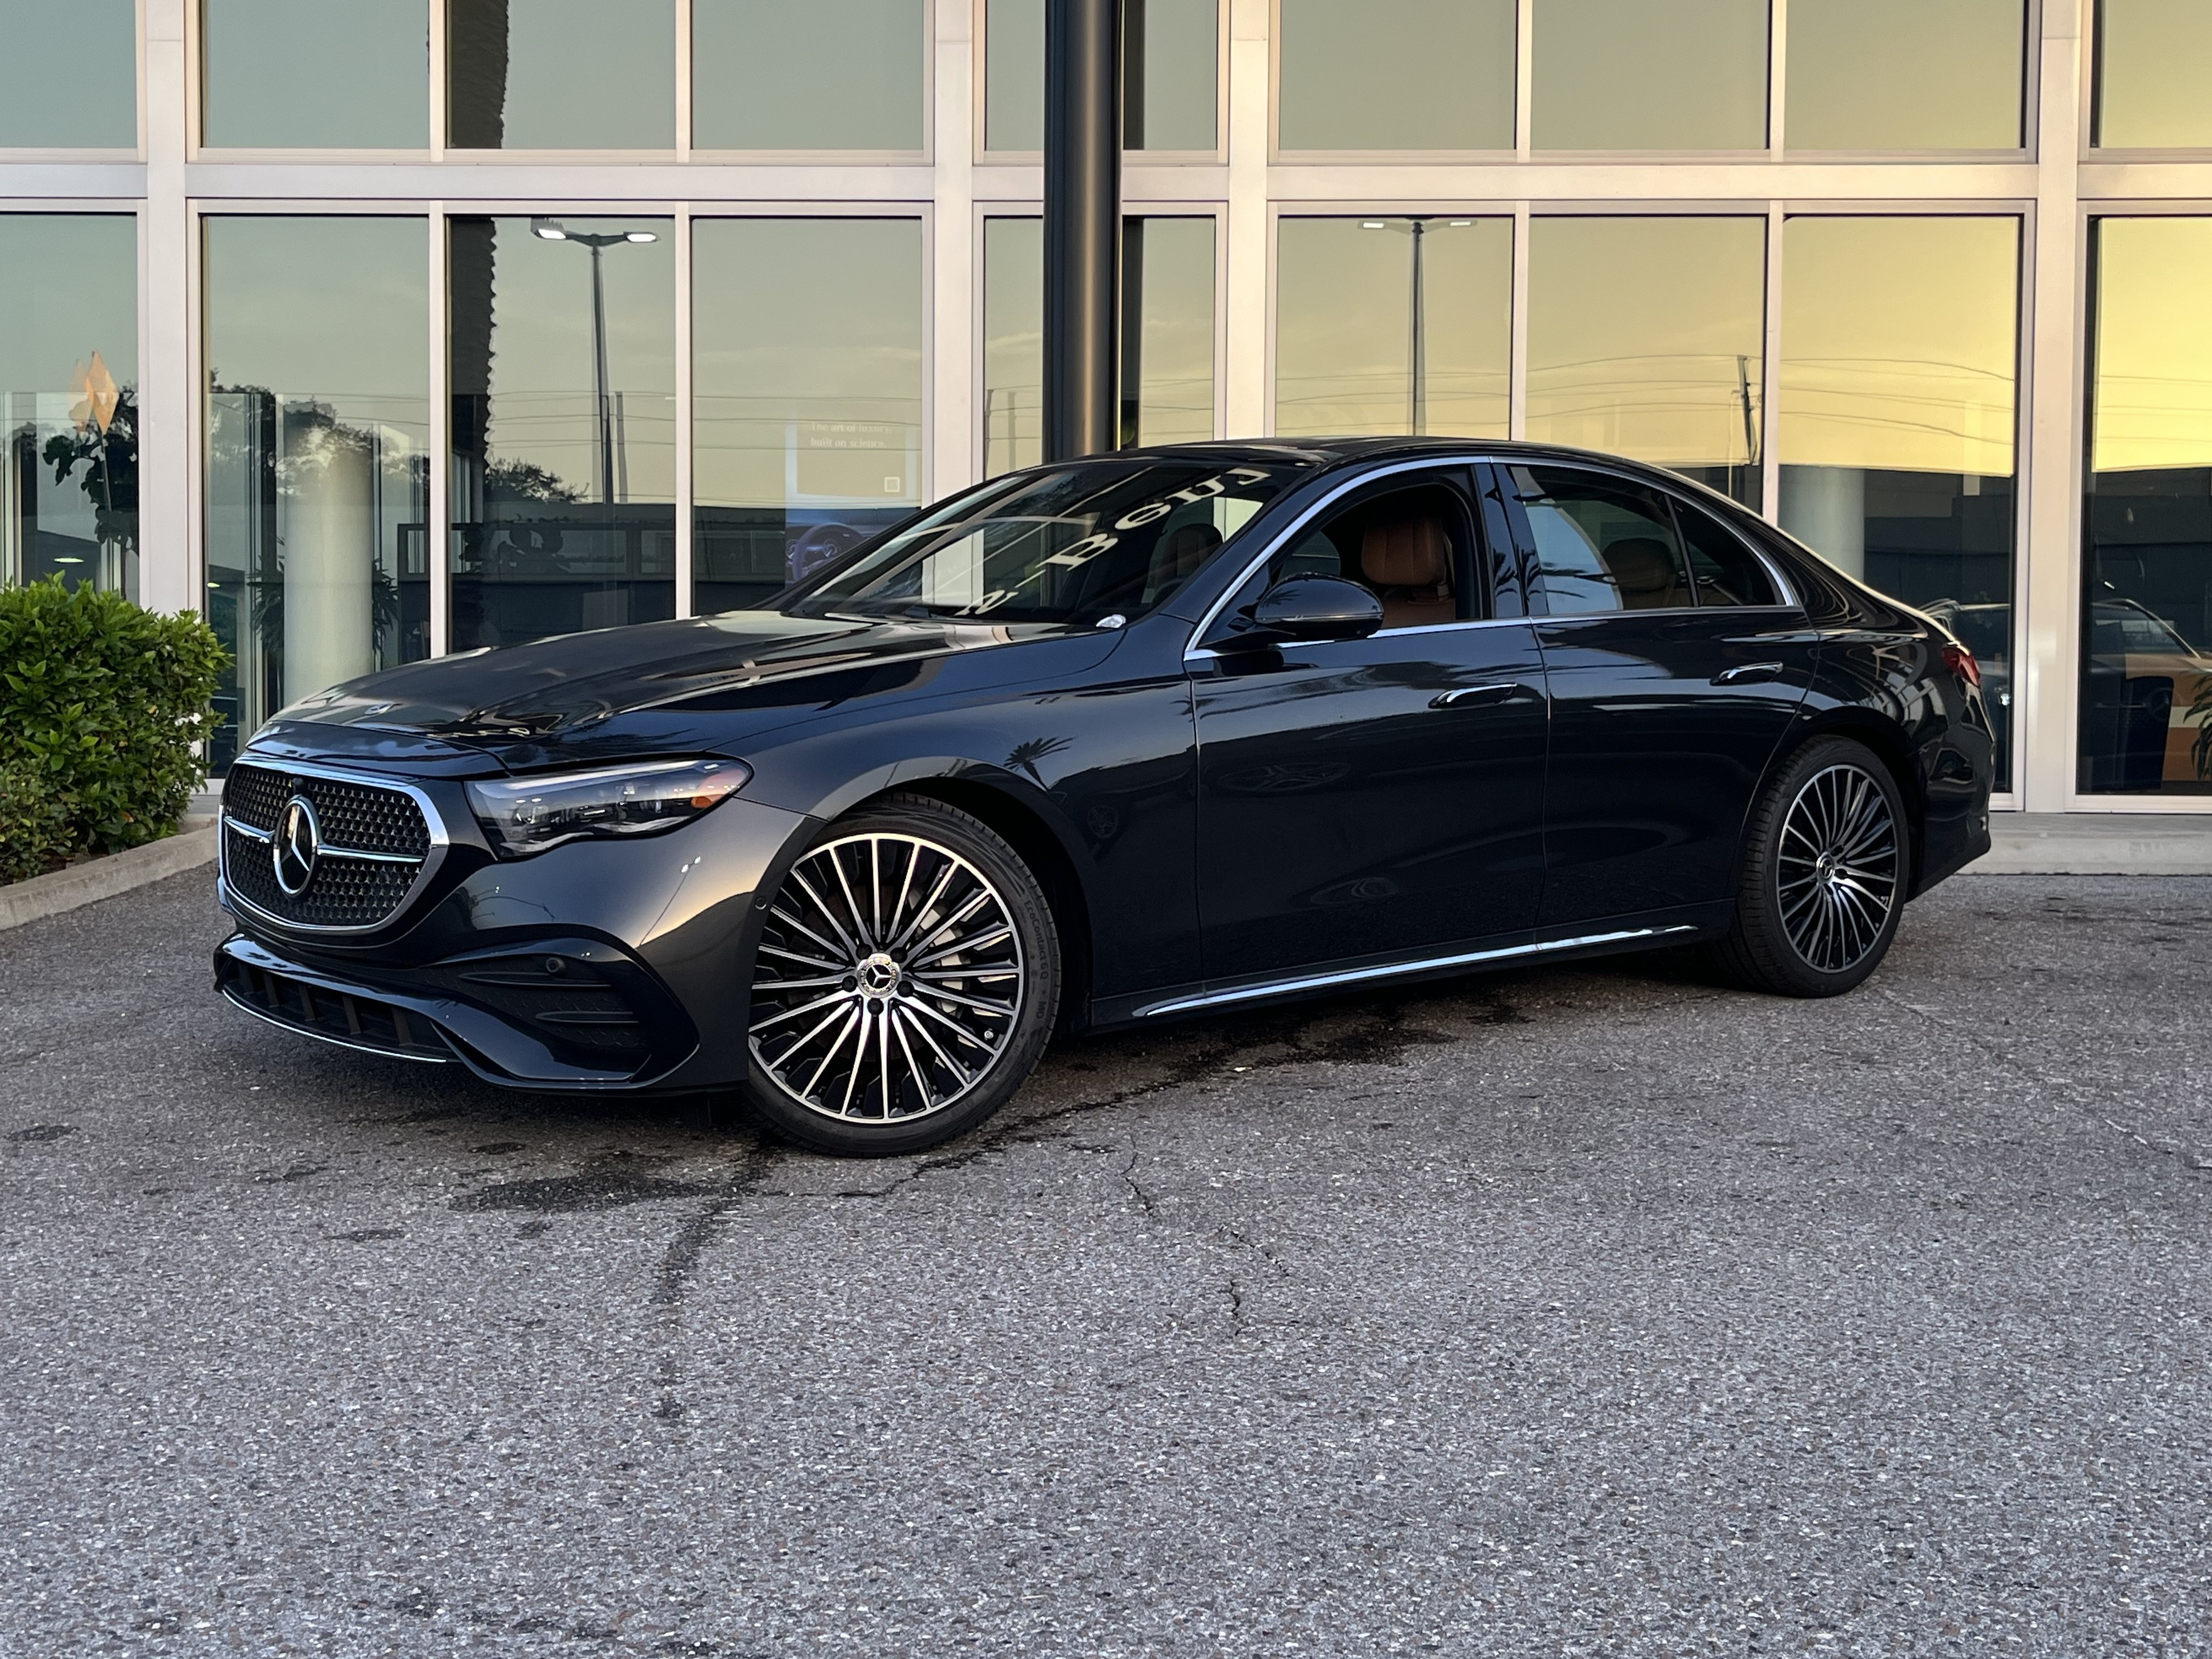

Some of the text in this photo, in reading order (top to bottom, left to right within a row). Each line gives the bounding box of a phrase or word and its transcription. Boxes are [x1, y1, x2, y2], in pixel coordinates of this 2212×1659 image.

[830, 424, 844, 432] art
[847, 424, 856, 433] of
[810, 437, 832, 447] built
[849, 438, 887, 448] science.
[1024, 900, 1047, 961] EcoContact
[1036, 1001, 1047, 1019] MO
